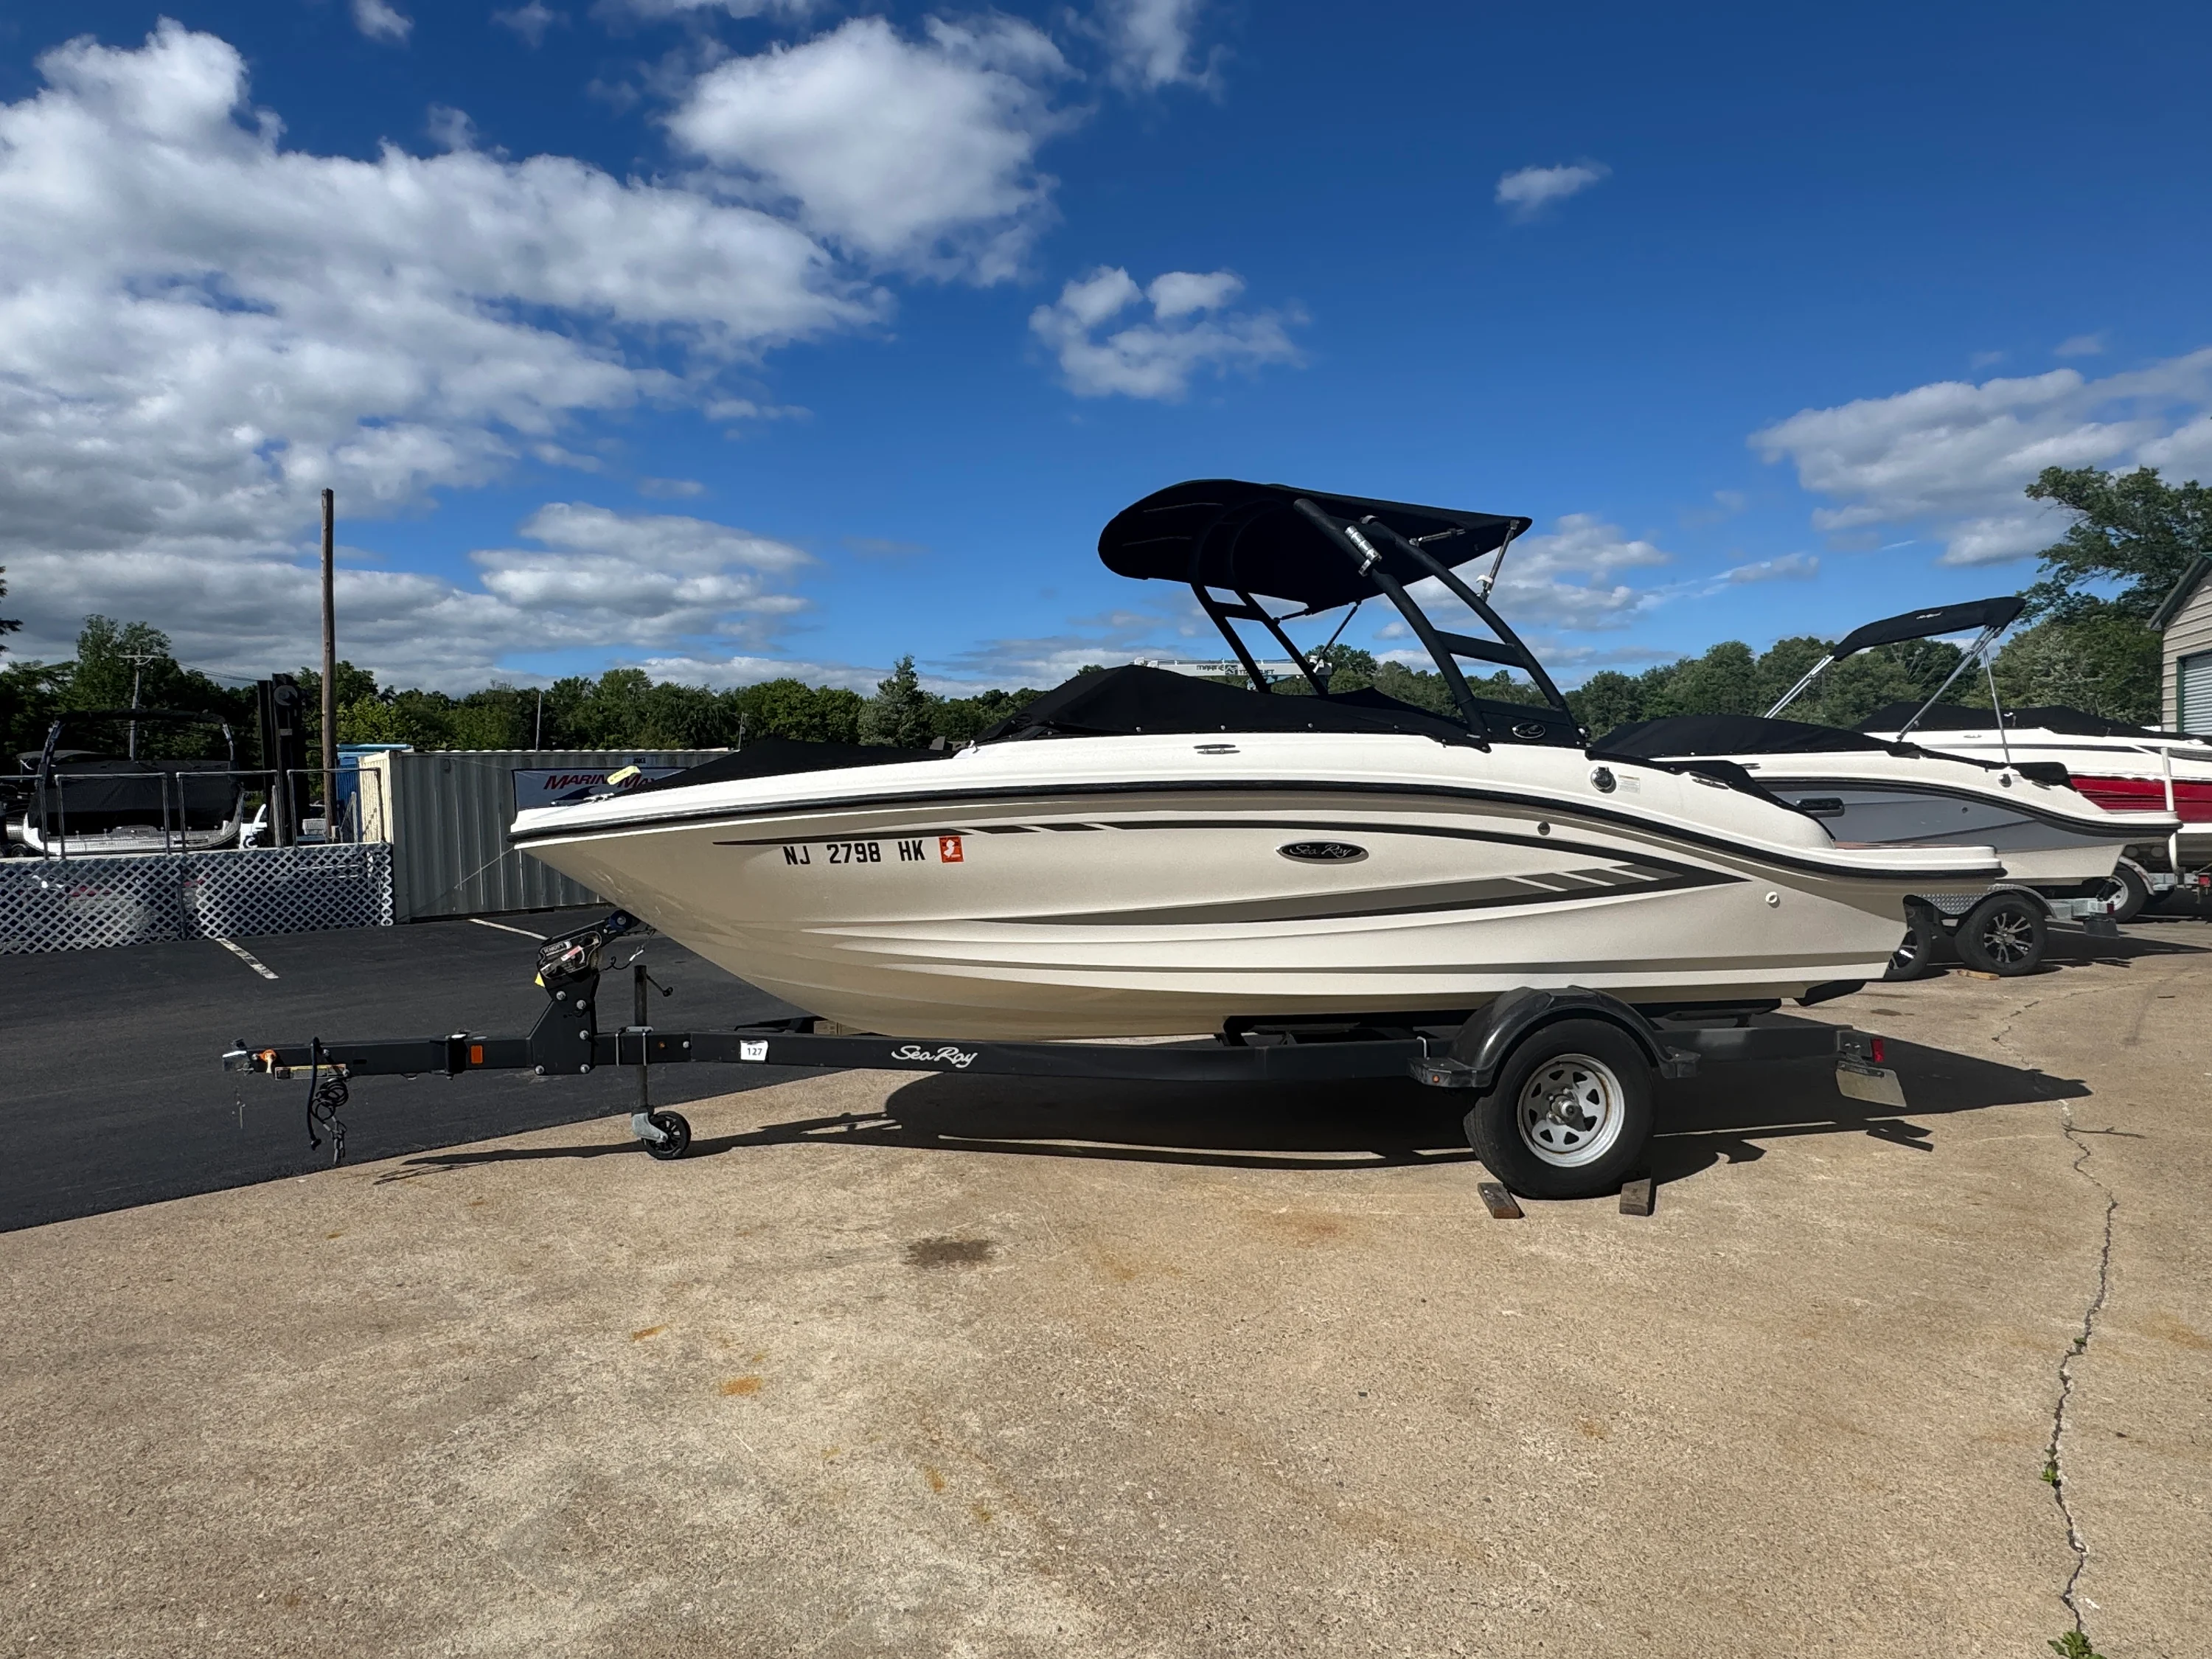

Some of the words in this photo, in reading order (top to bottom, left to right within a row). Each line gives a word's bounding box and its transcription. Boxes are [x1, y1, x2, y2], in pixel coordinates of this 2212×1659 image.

[543, 774, 609, 790] MARIN
[782, 846, 811, 865] NJ
[827, 842, 882, 864] 2798
[897, 840, 926, 861] HK
[1289, 844, 1318, 855] Sea
[1321, 844, 1353, 858] Ray
[747, 1047, 763, 1056] 127
[891, 1045, 936, 1061] Sea
[933, 1046, 978, 1068] Ray
